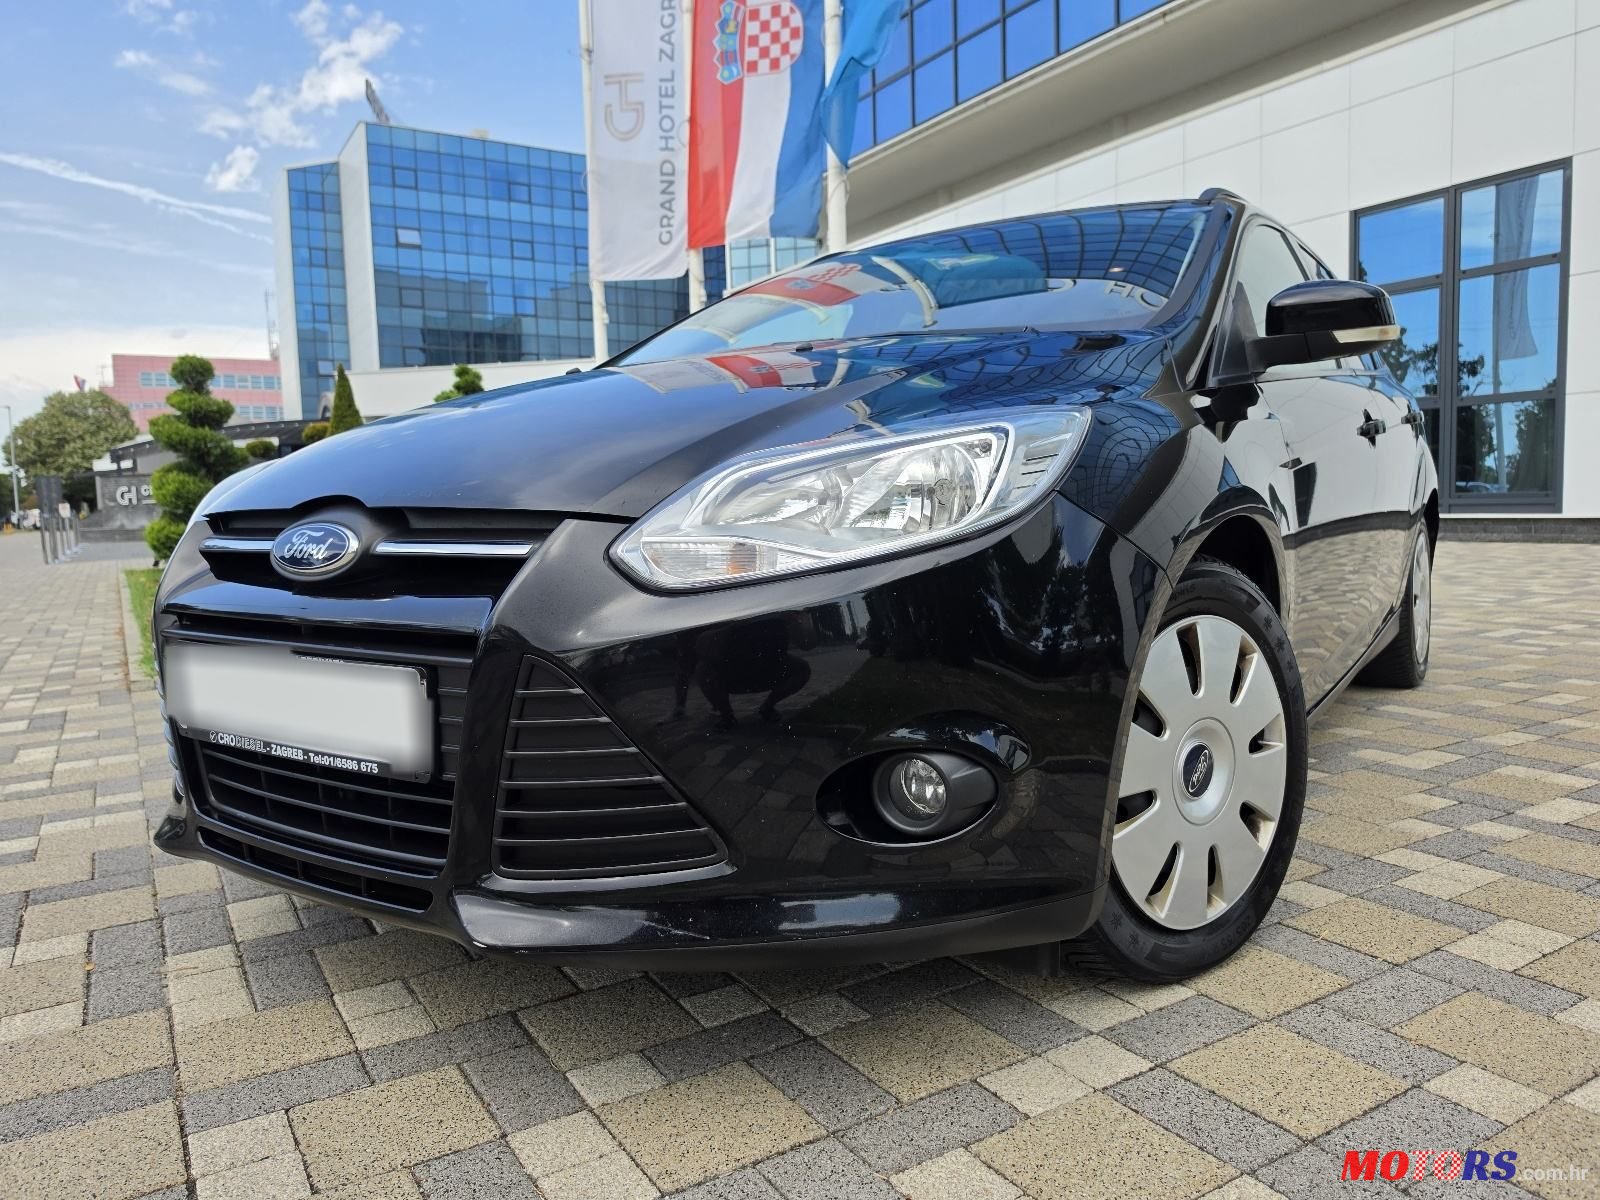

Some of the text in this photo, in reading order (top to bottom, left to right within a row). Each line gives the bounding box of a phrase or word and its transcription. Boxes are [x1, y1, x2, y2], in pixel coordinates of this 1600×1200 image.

[658, 70, 676, 152] HOTEL
[658, 159, 676, 246] GRAND
[284, 529, 334, 560] Ford
[360, 762, 379, 774] 675
